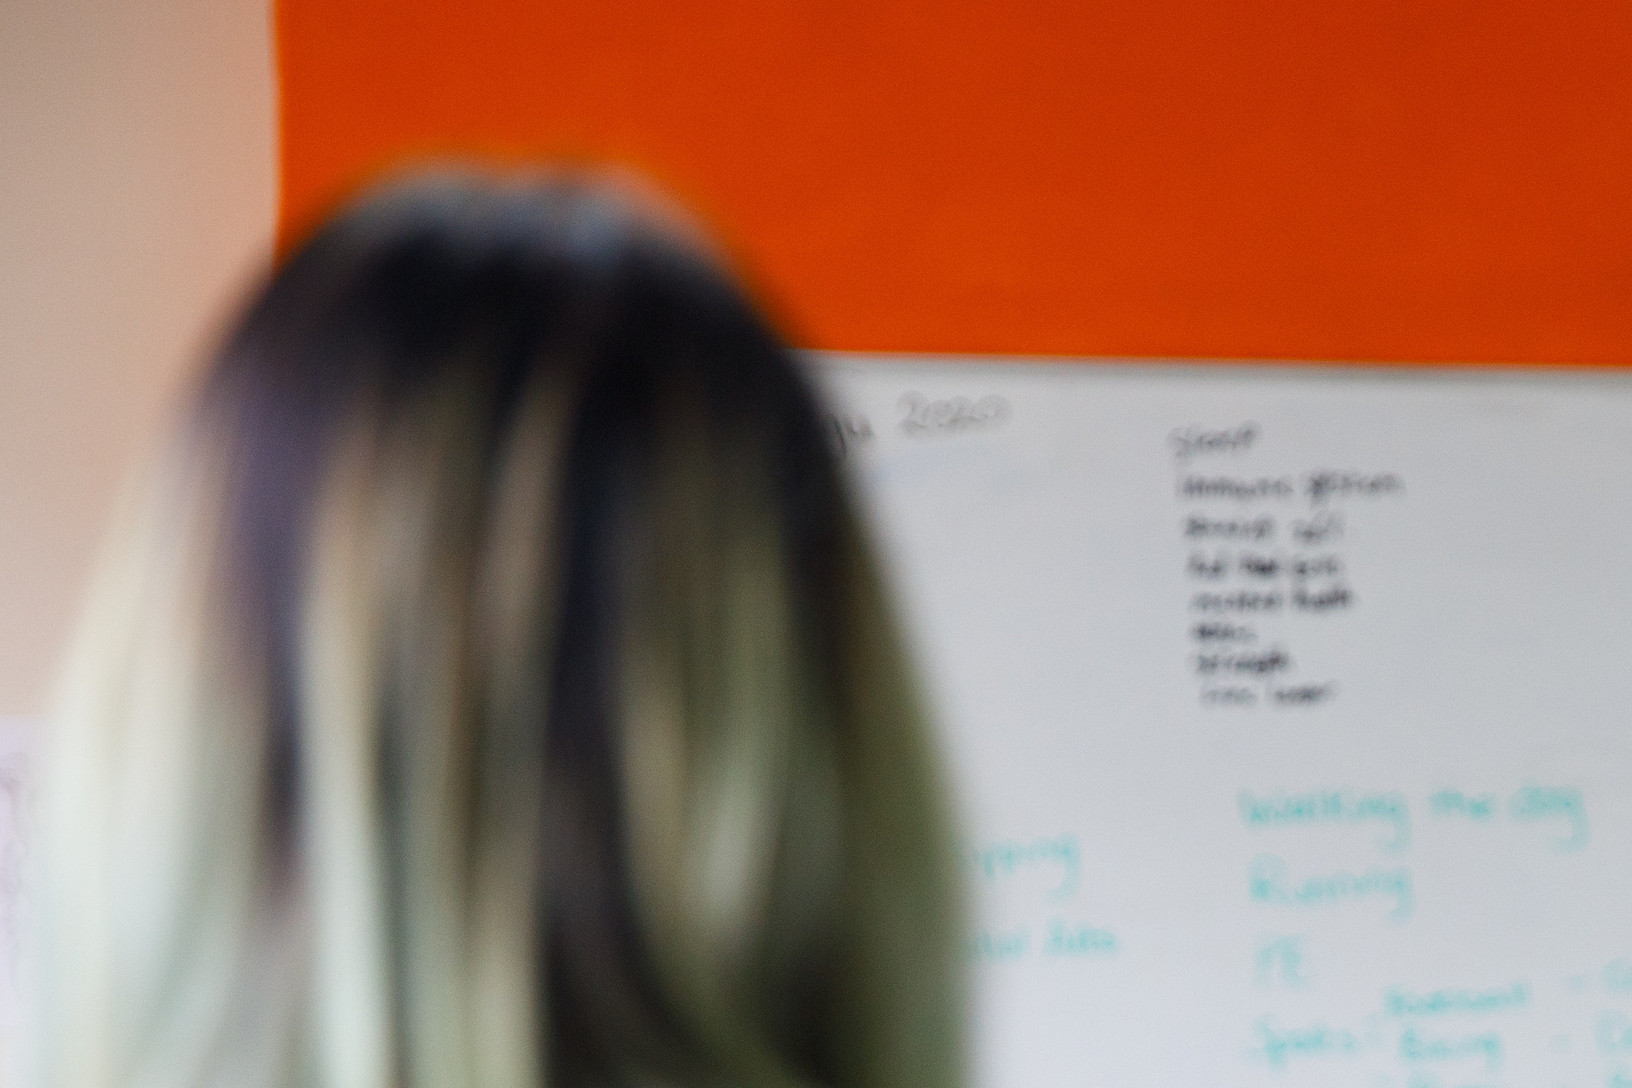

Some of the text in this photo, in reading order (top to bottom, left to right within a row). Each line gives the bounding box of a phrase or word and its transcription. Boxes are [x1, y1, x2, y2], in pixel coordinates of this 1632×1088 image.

[1242, 786, 1586, 854] Walking the dog
[1250, 856, 1412, 922] Running
